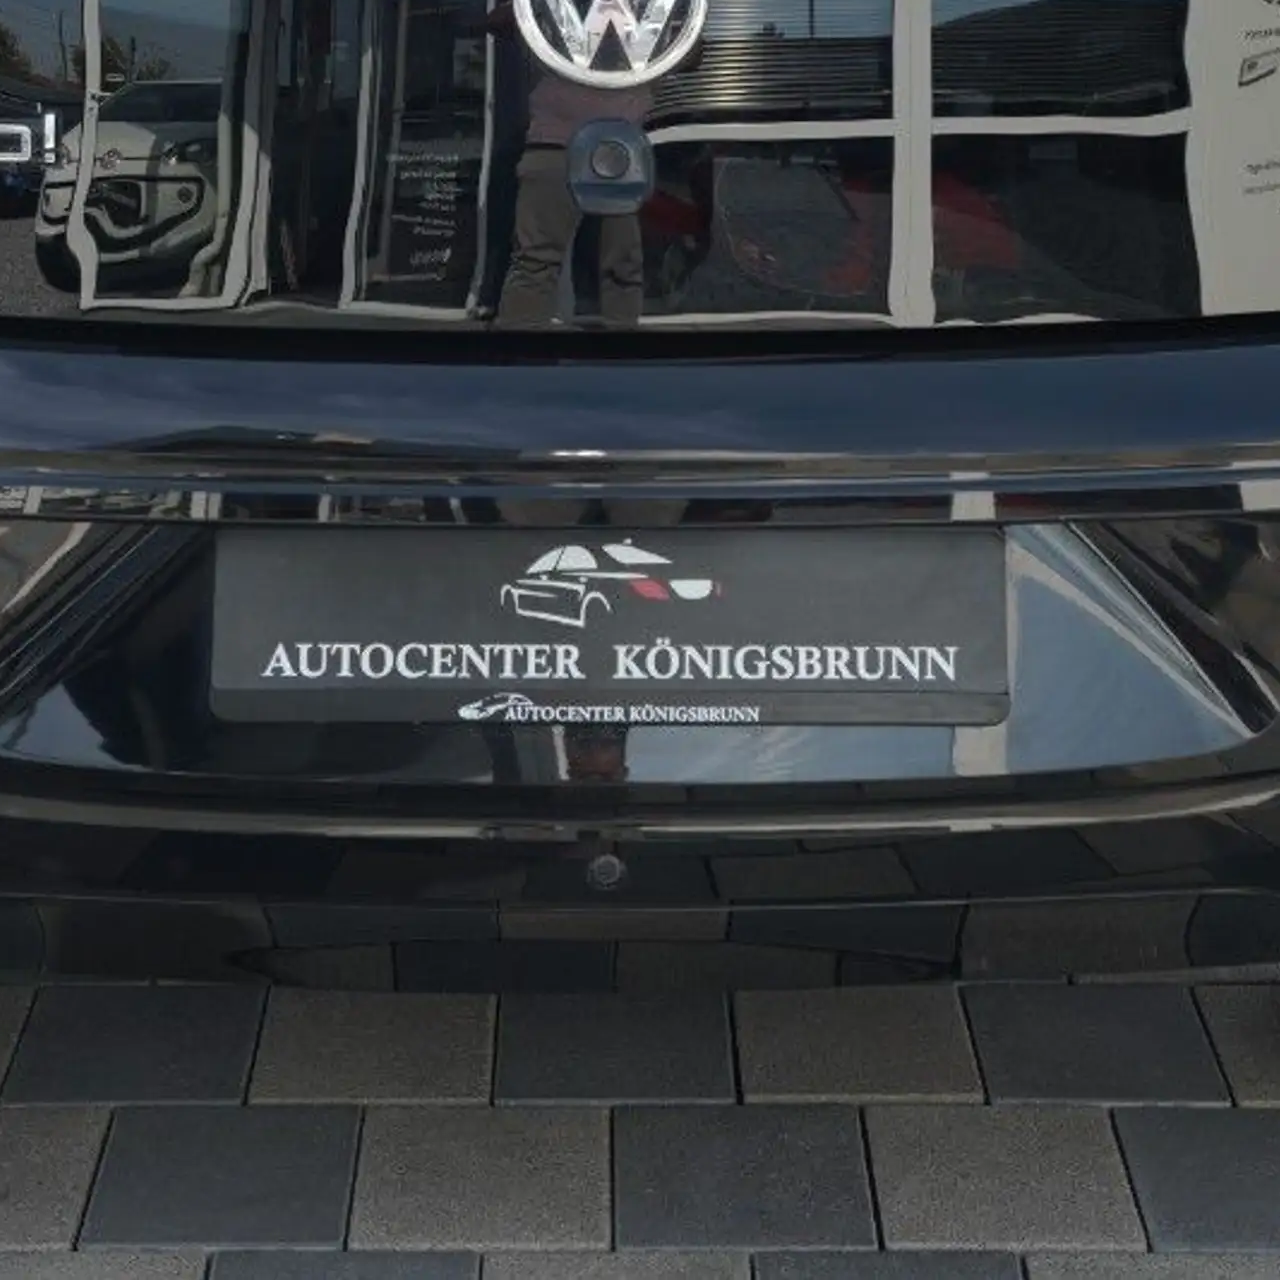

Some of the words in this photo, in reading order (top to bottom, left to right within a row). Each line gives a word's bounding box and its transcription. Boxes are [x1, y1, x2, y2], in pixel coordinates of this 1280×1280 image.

[261, 642, 586, 680] AUTOCENTER
[612, 636, 960, 682] KÖNIGSBRUNN
[504, 703, 625, 723] AUTOCENTER
[629, 702, 760, 723] KÖNIGSBRUNN
